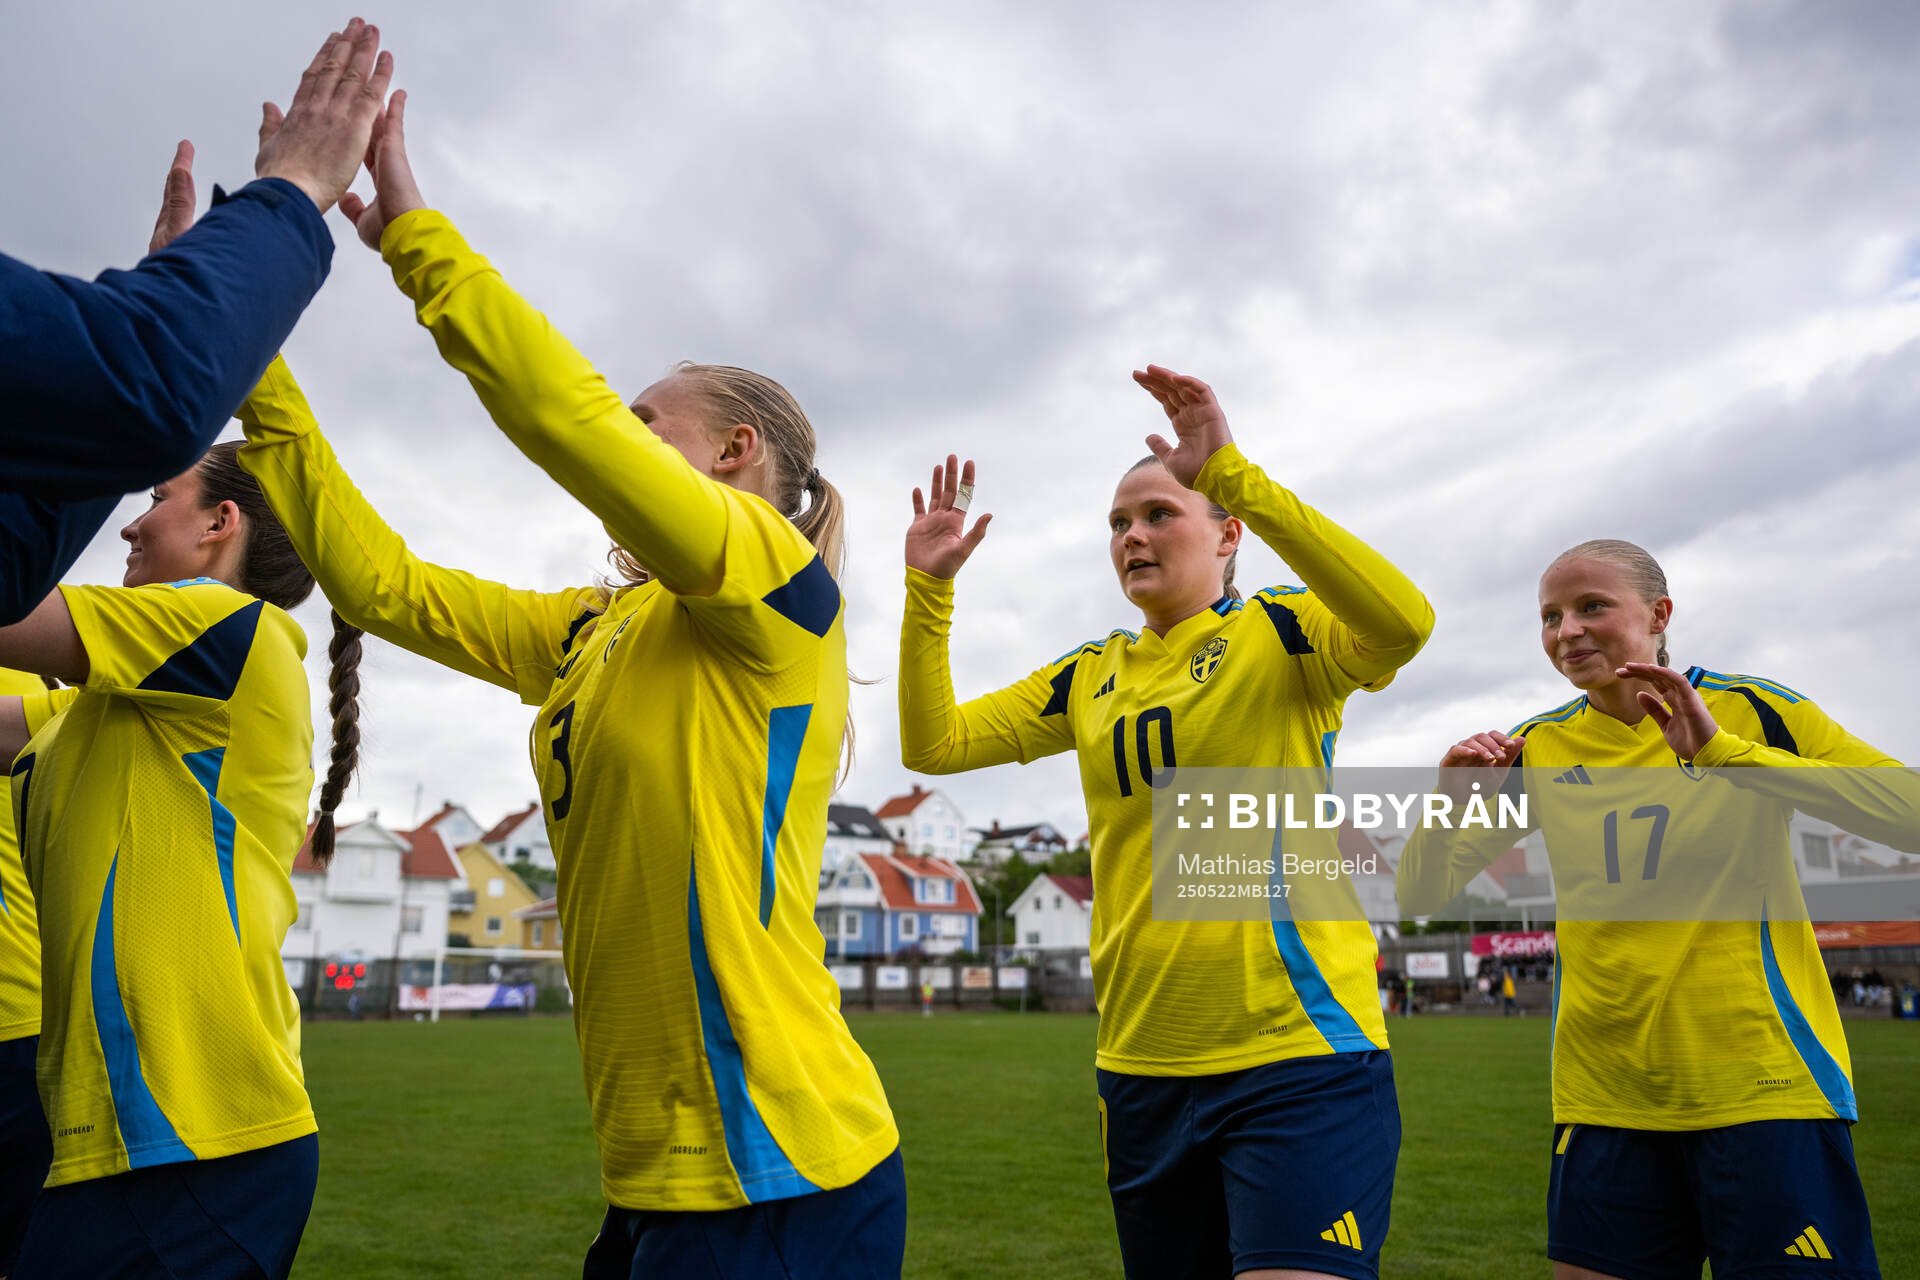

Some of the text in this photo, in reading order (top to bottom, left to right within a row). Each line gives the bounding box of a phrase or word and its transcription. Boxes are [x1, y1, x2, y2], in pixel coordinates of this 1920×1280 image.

[549, 700, 576, 822] 3
[1113, 706, 1177, 797] 10
[1603, 804, 1671, 884] 17
